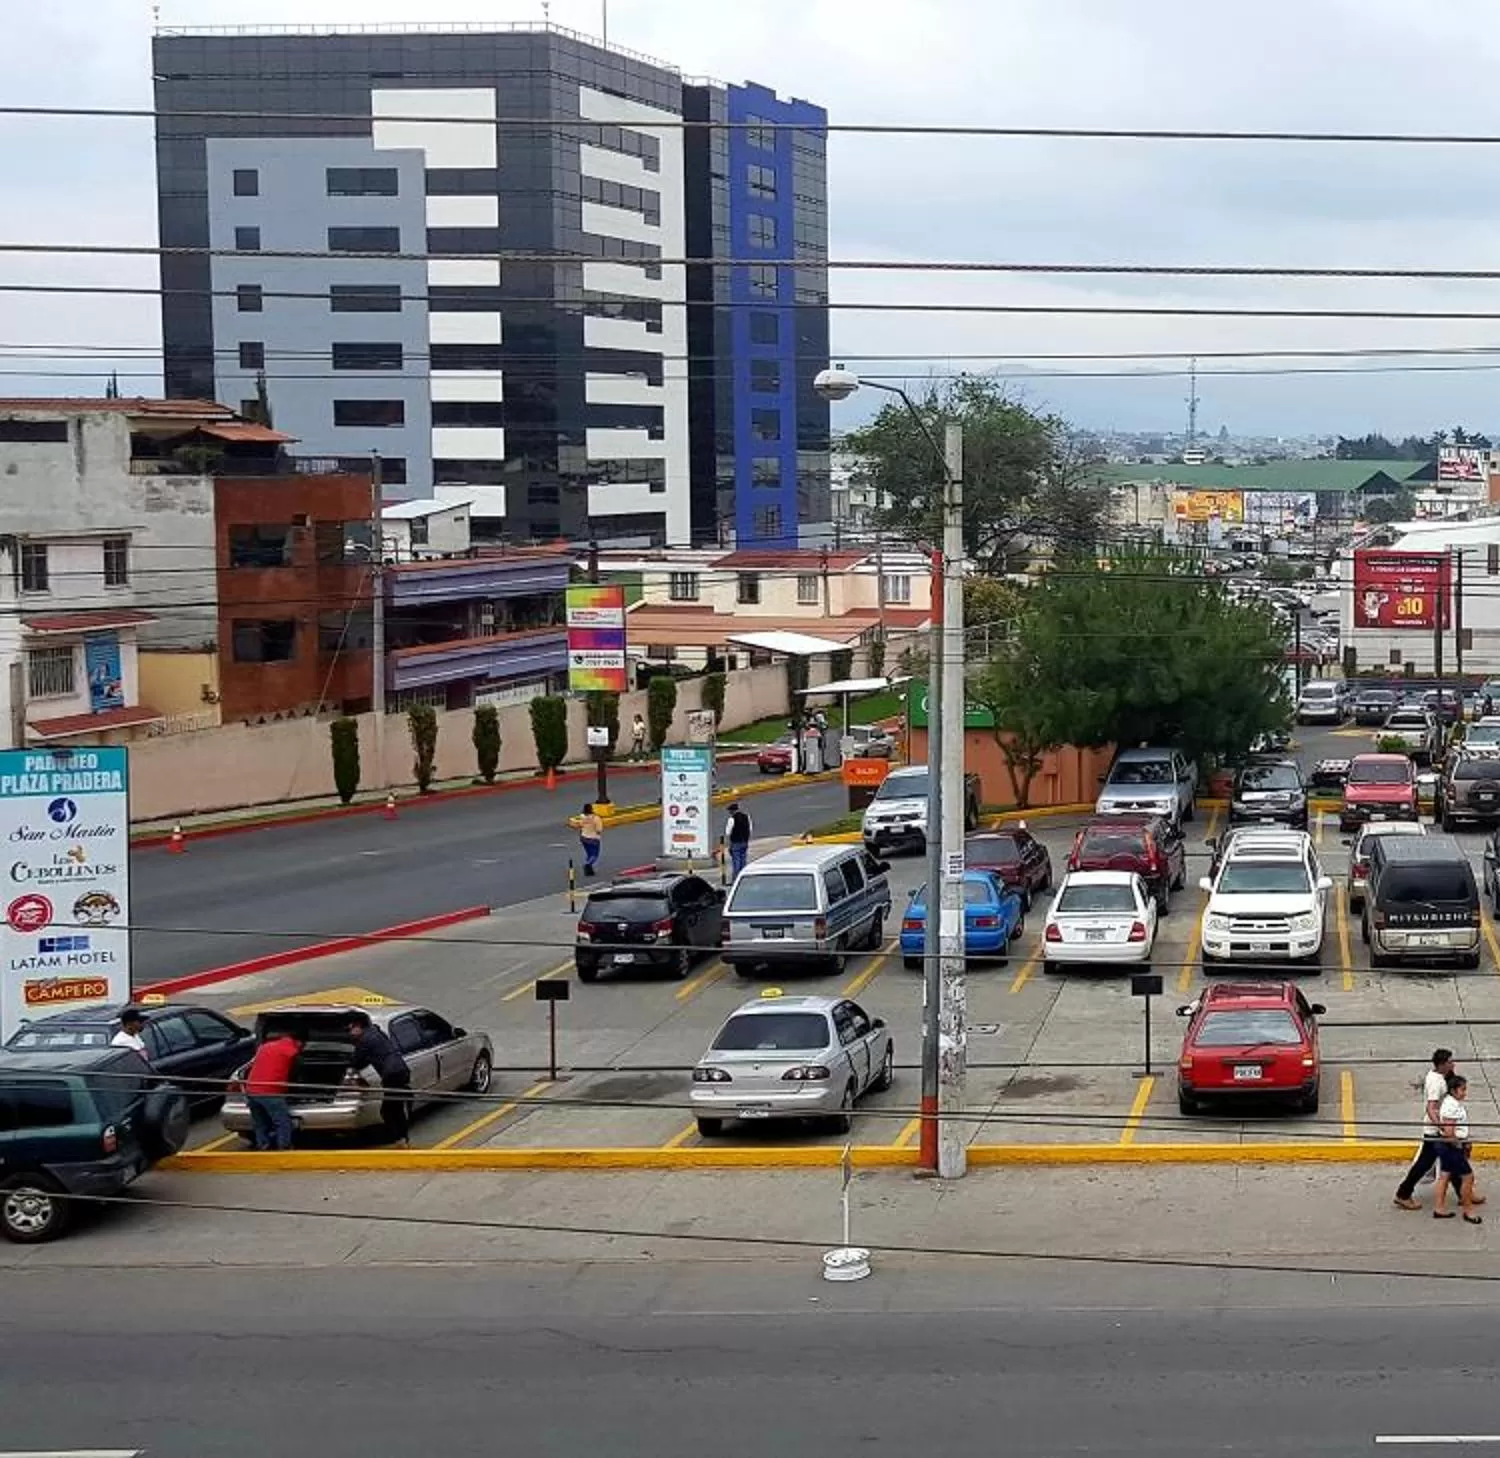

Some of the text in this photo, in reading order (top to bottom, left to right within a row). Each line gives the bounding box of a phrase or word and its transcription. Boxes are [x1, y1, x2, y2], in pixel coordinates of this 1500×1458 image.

[25, 753, 98, 772] PARQUEO
[1, 770, 122, 794] PLAZA PRADERA
[9, 825, 46, 842] San
[10, 861, 117, 883] CEBOLLINES
[1389, 913, 1468, 922] MITSUBISHI
[11, 951, 116, 971] LATAM HOTEL
[27, 982, 106, 1001] CAMPERO
